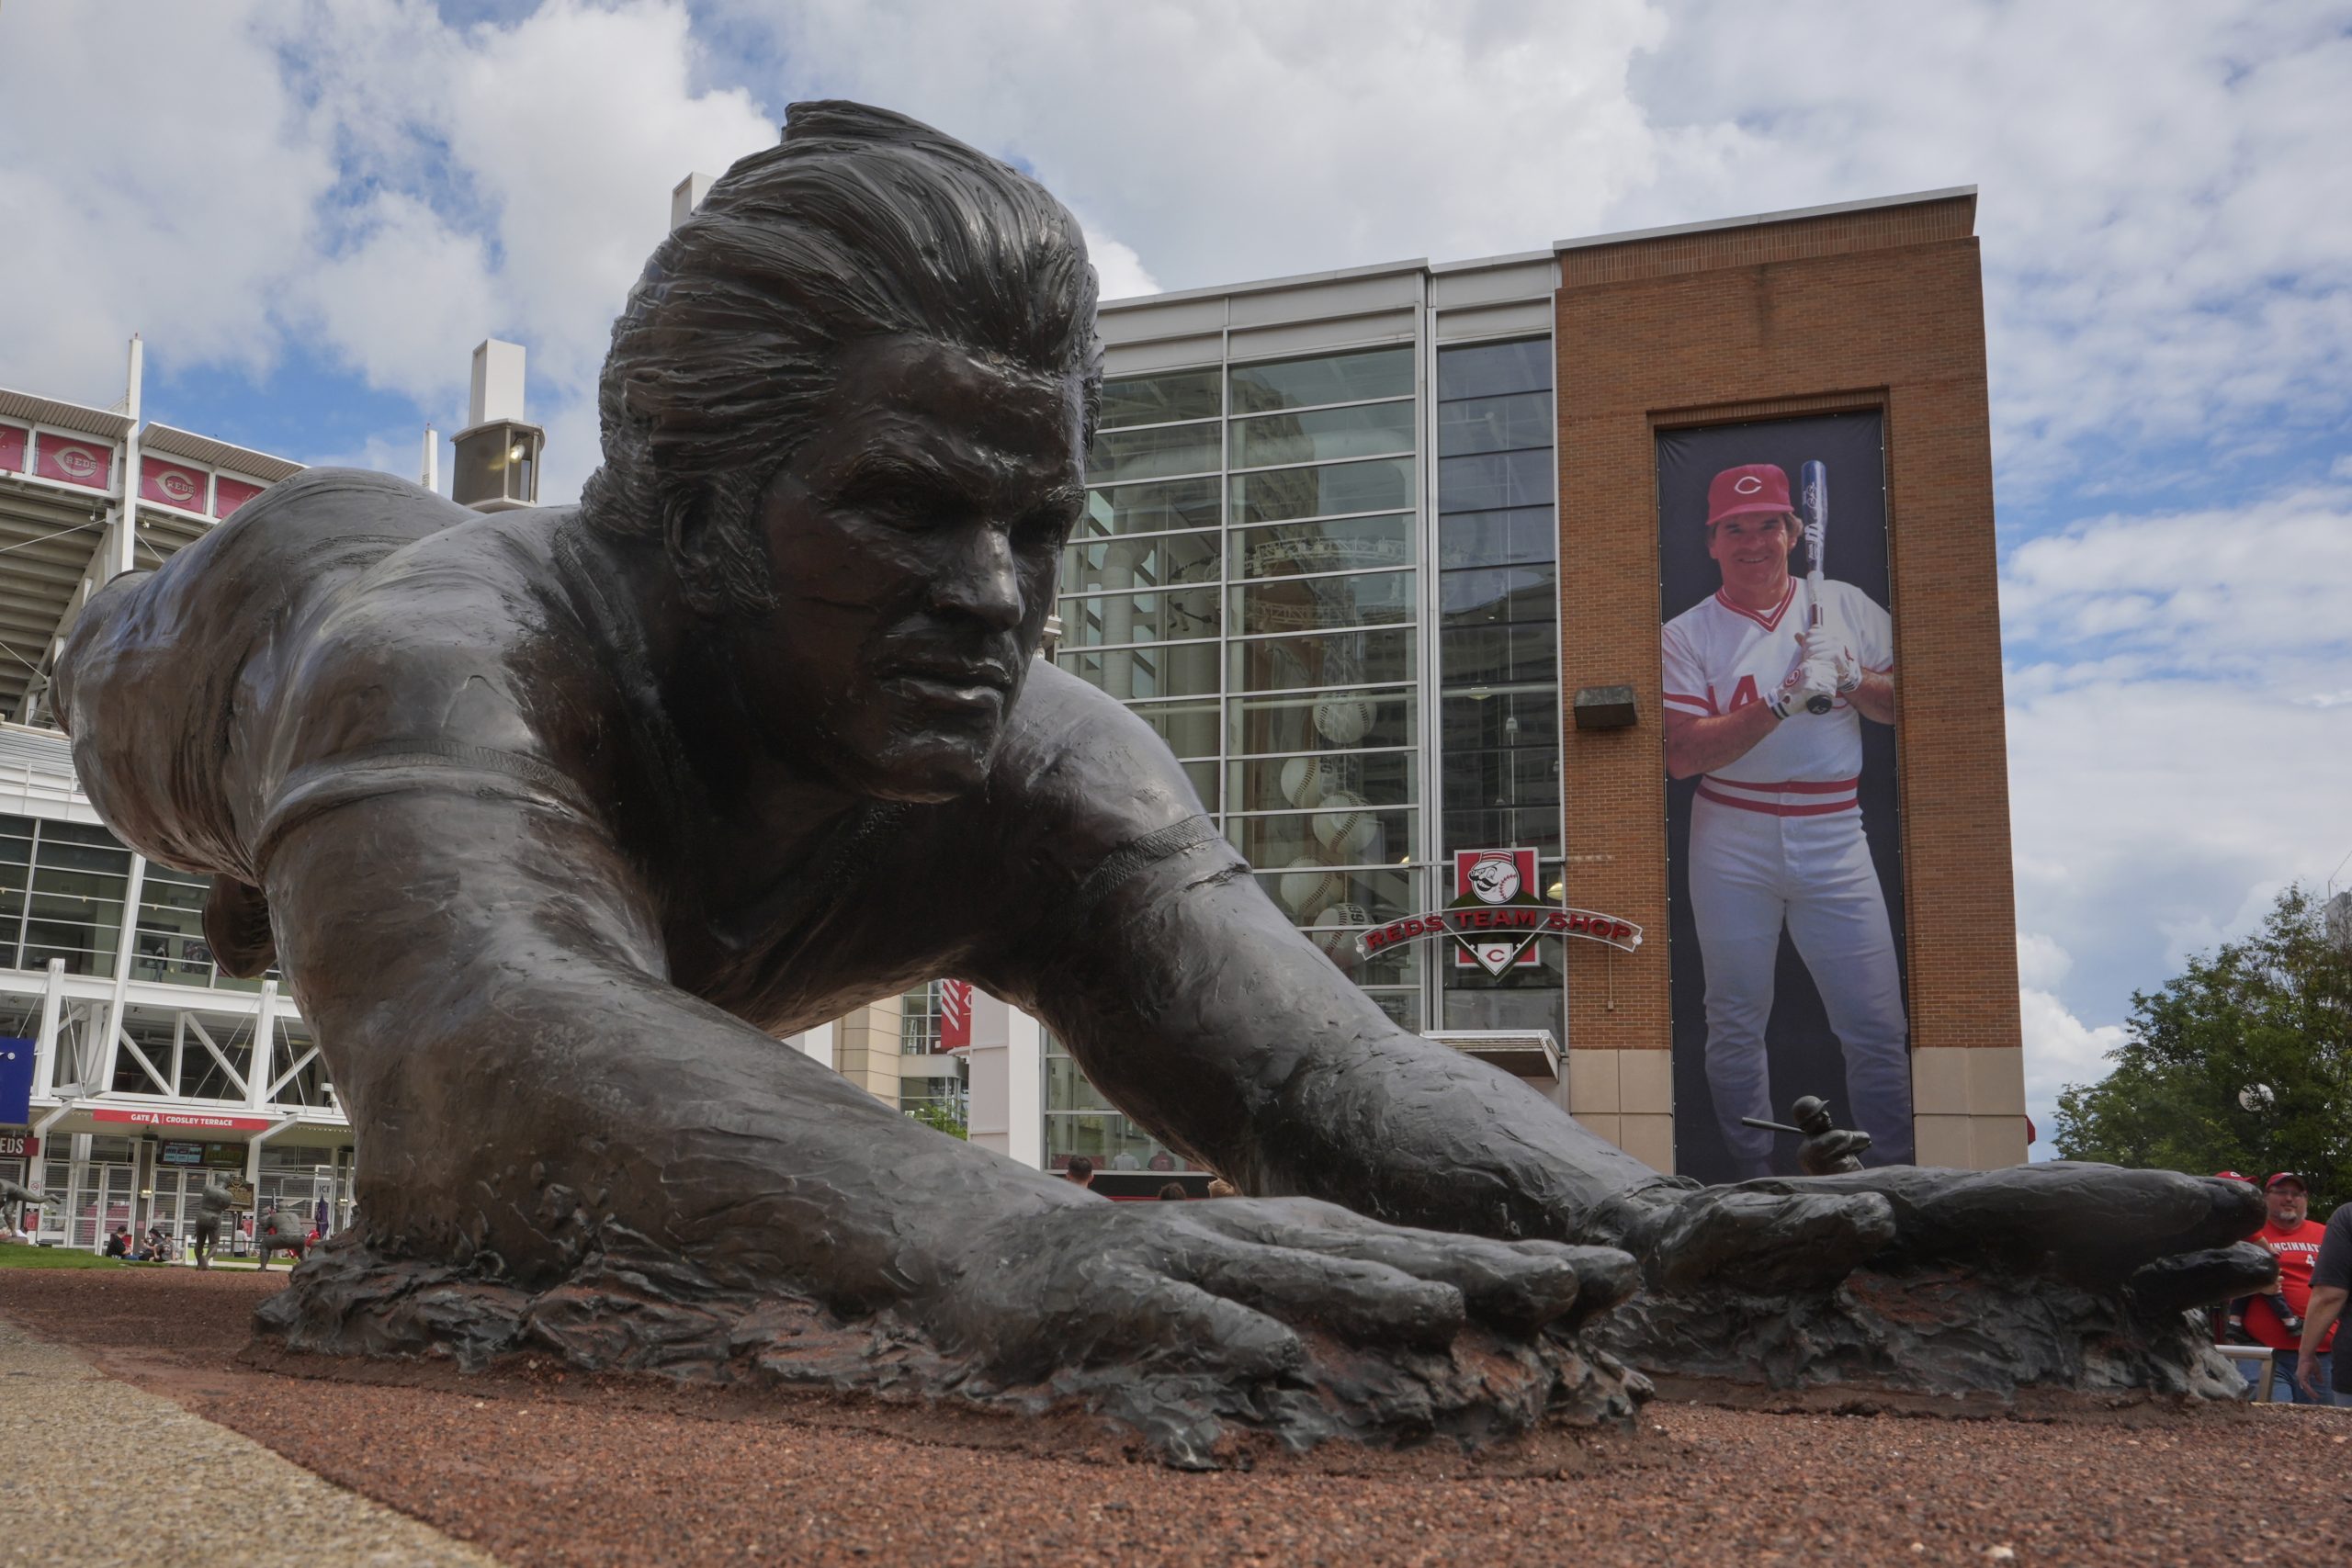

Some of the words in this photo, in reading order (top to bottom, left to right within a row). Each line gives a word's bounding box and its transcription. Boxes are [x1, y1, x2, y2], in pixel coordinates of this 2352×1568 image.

[65, 456, 96, 470] REDS
[166, 480, 195, 494] REDS
[1734, 476, 1762, 494] C
[1365, 915, 1443, 952] REDS
[1454, 910, 1536, 928] TEAM
[1549, 911, 1632, 941] SHOP
[1486, 949, 1505, 963] C
[130, 1113, 150, 1122] GATE
[151, 1113, 159, 1123] A
[200, 1118, 232, 1126] TERRACE
[2269, 1242, 2321, 1253] INCINNAT
